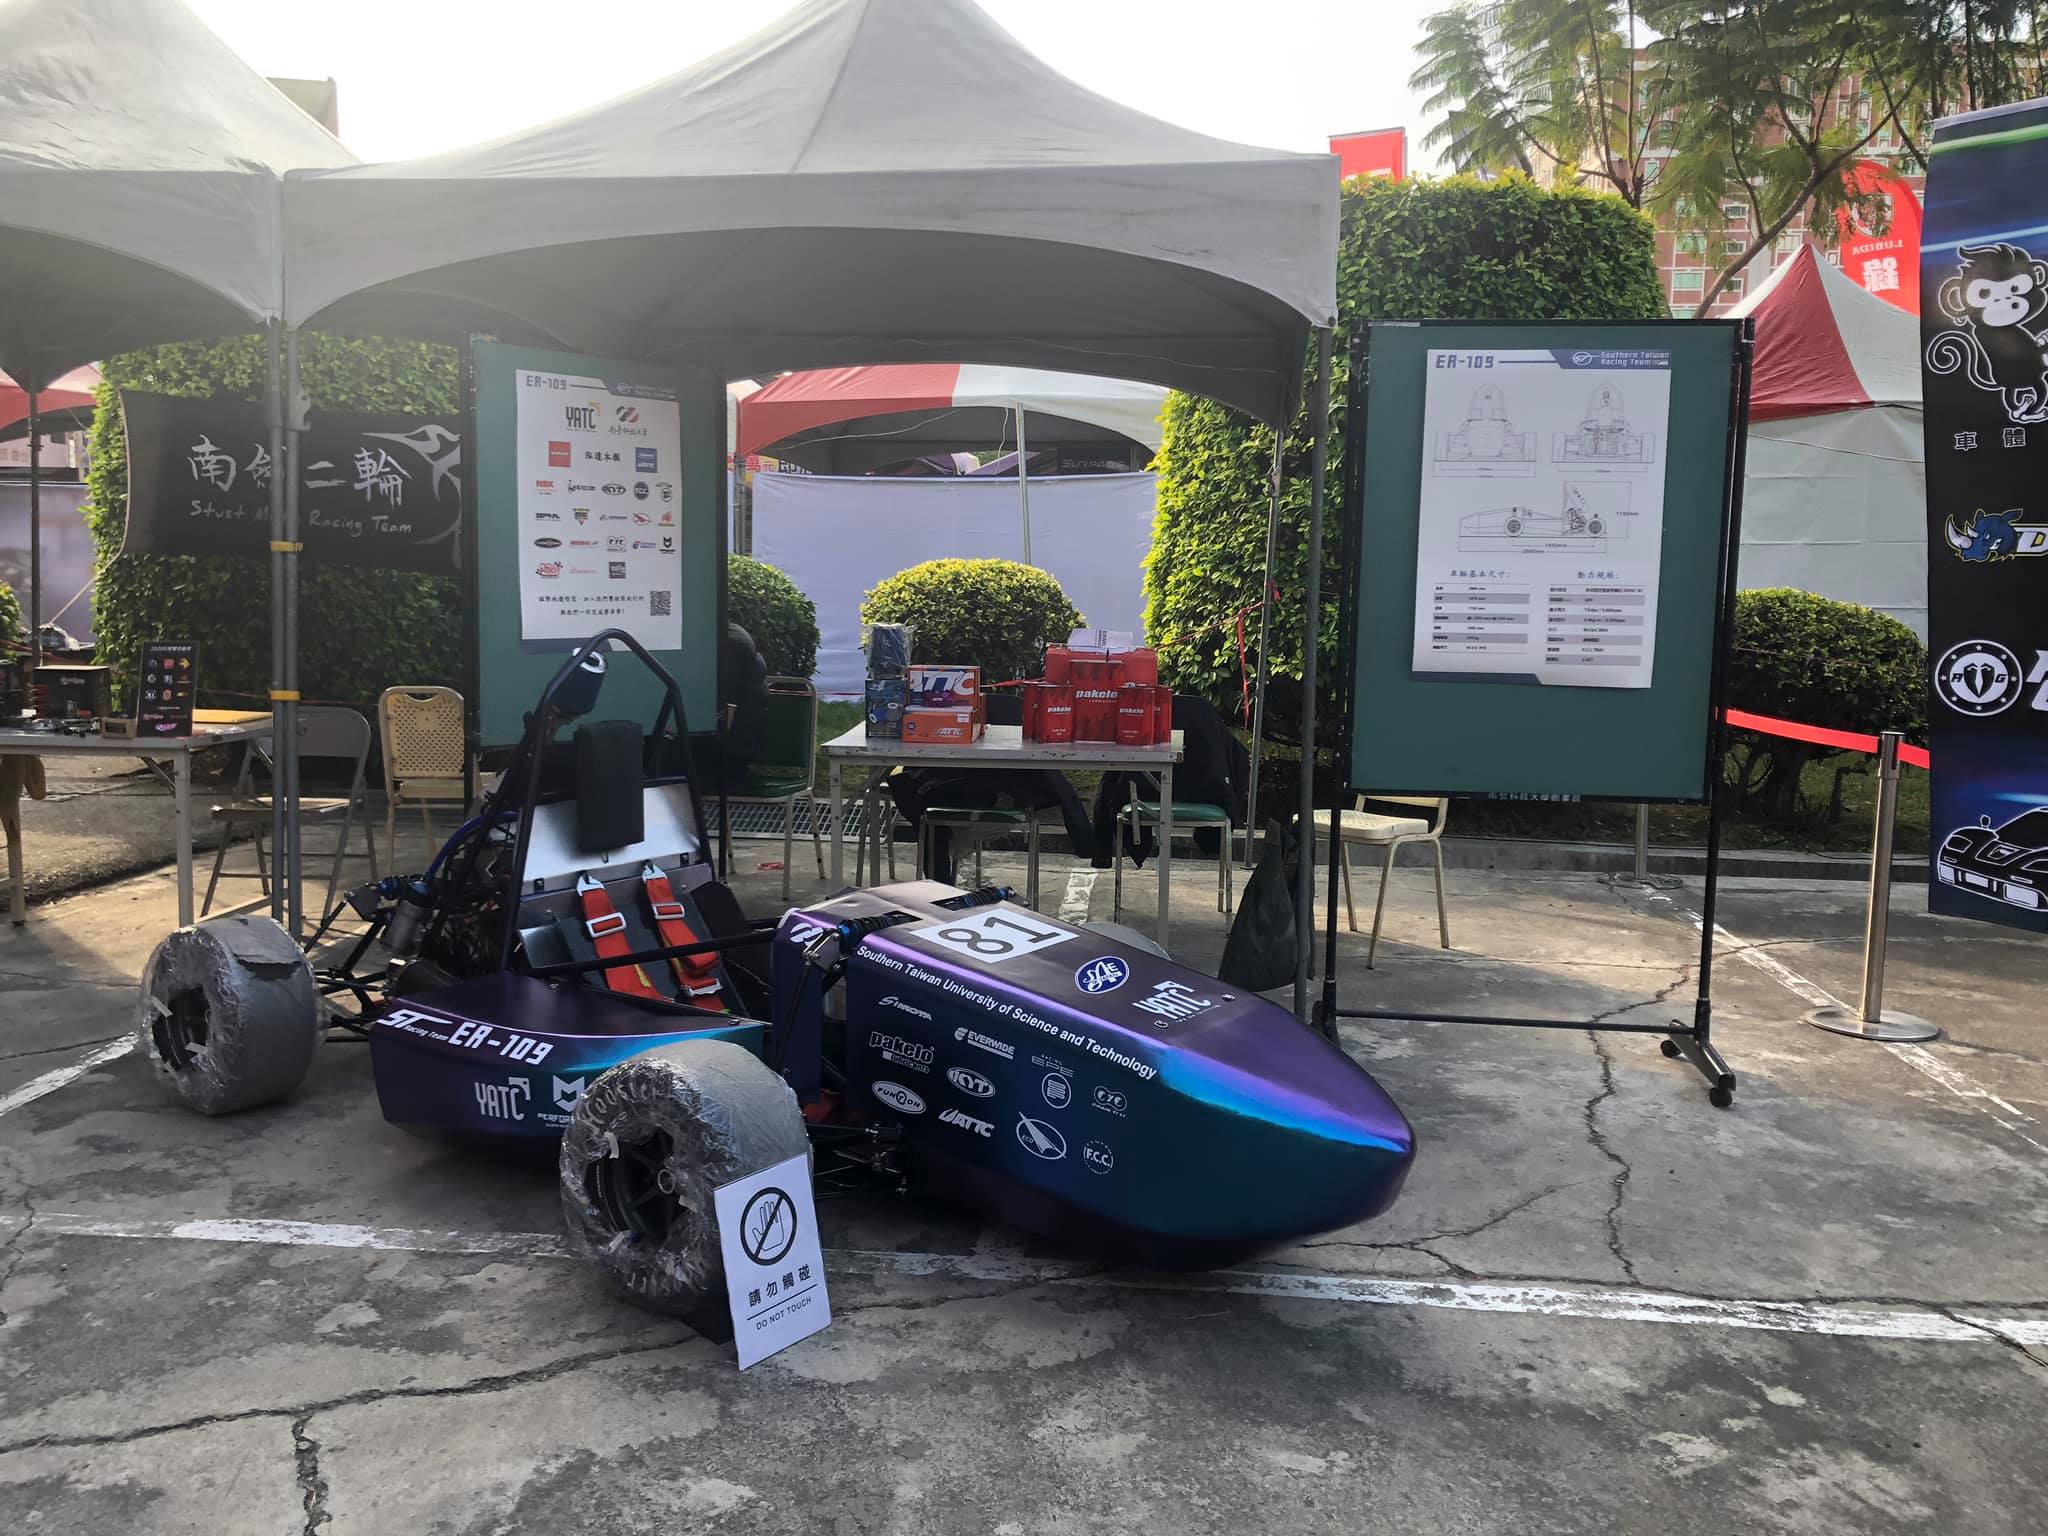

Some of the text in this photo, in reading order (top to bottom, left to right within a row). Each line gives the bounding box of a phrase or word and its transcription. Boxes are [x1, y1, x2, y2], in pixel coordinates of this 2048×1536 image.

[1600, 351, 1638, 359] Southern
[1600, 359, 1628, 368] Racing
[1954, 427, 2026, 451] 車體
[309, 509, 363, 538] Racing
[371, 515, 412, 534] Team
[1075, 689, 1118, 699] pakelo
[938, 916, 1061, 955] 81
[857, 945, 1158, 1080] Southern Taiwan University of Science and Technology
[869, 1031, 934, 1064] pakelo
[967, 1031, 1016, 1055] EVERWIDE
[475, 1082, 525, 1120] YATC
[748, 1264, 811, 1308] 請勿觸碰
[756, 1296, 812, 1330] DO NOT TOUCH
